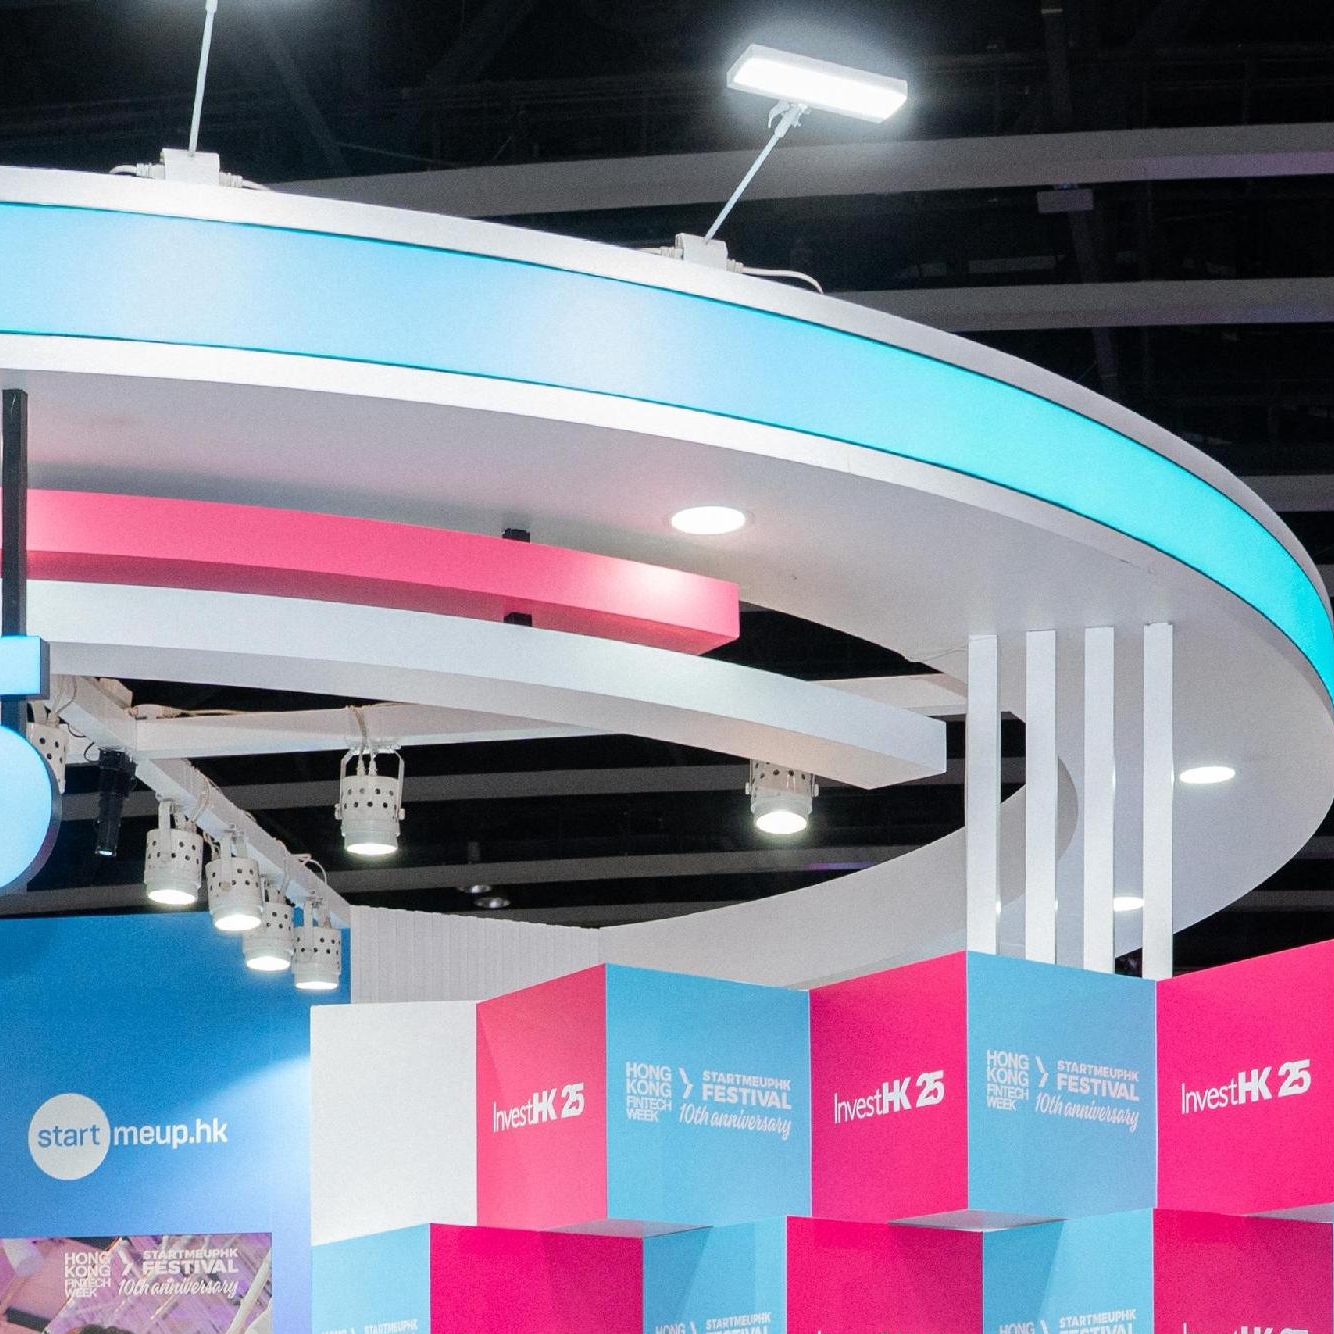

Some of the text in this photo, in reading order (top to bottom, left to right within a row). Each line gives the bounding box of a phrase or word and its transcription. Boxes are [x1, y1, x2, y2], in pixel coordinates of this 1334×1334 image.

[987, 1051, 1028, 1070] HONG
[626, 1063, 671, 1082] HONG
[987, 1067, 1028, 1086] KONG
[627, 1079, 671, 1097] KONG
[1058, 1073, 1139, 1101] FESTIVAL
[1182, 1059, 1311, 1114] InvestHK 25
[703, 1084, 791, 1109] FESTIVAL
[835, 1070, 944, 1123] InvestHK 25
[494, 1083, 585, 1132] InvestHK 25
[64, 1251, 109, 1265] HONG
[140, 1259, 239, 1275] FESTIVAL
[64, 1264, 109, 1277] KONG
